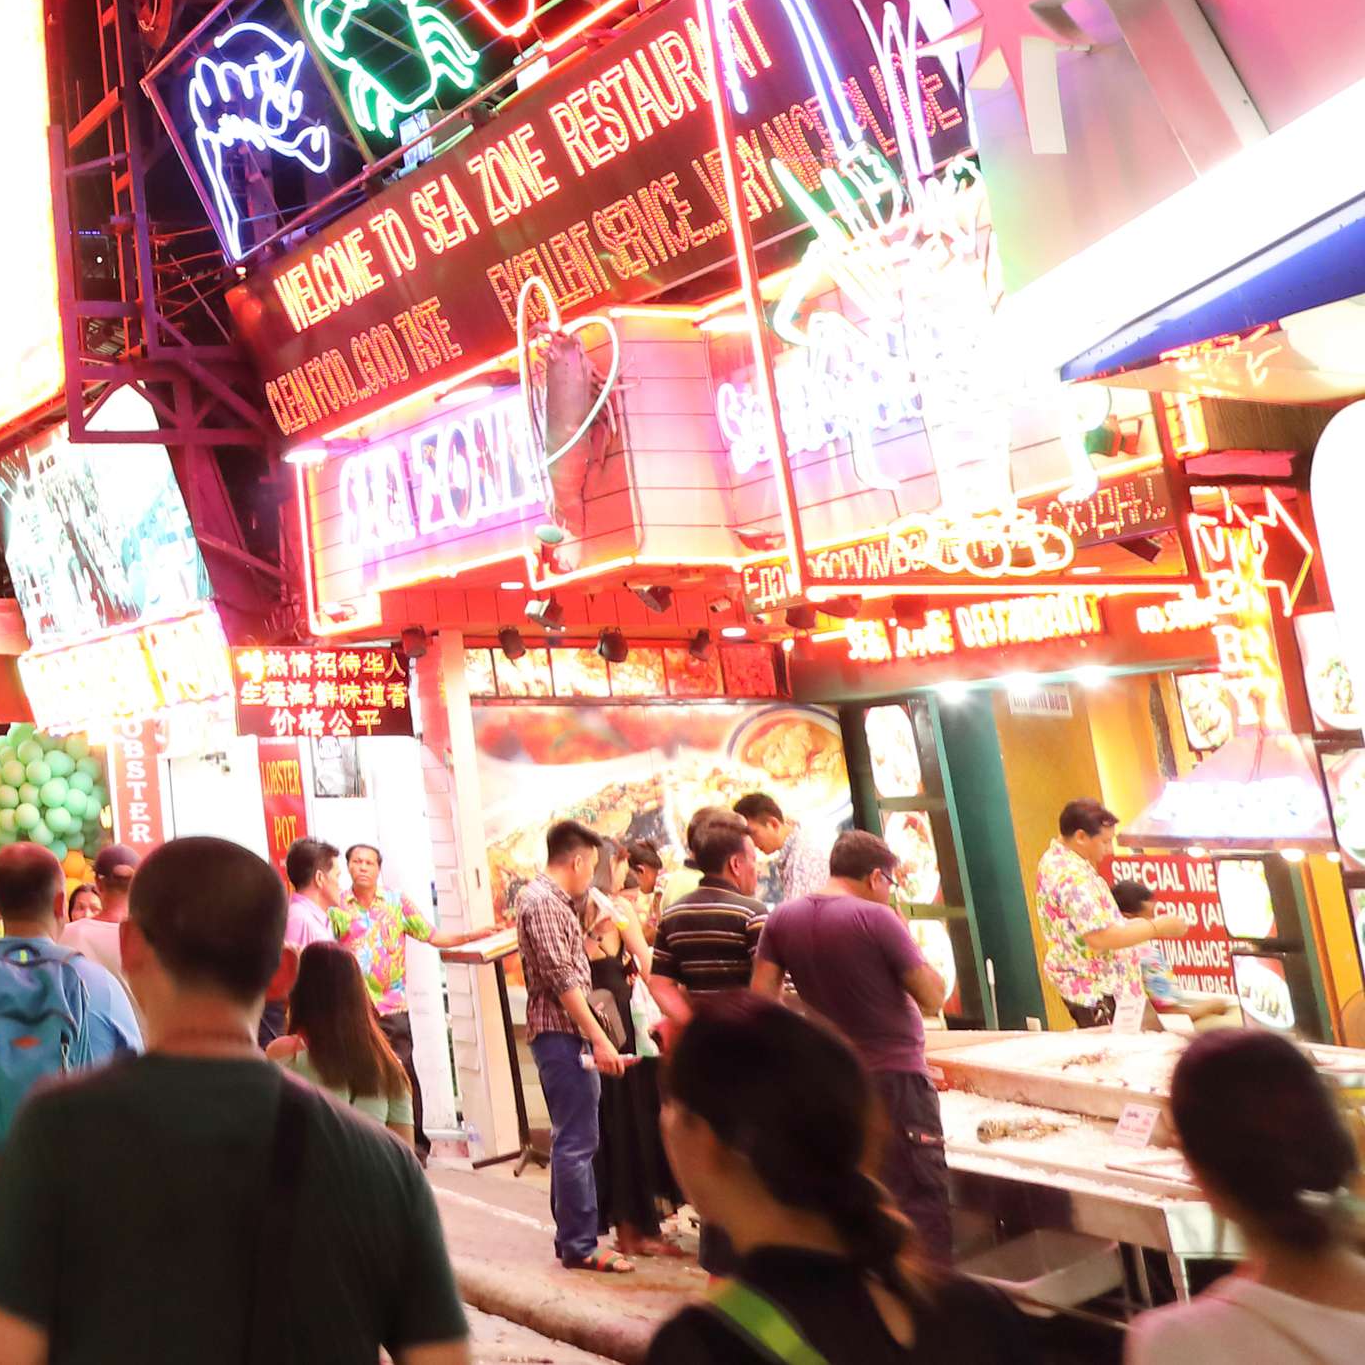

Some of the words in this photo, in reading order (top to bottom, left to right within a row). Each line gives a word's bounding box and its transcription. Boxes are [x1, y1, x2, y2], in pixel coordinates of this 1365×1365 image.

[272, 227, 385, 334] WELCOME
[370, 208, 417, 279] TO
[415, 172, 478, 255] SEA
[468, 123, 559, 227] ZONE
[392, 295, 464, 374] TASTE
[270, 708, 382, 738] 价格公平
[261, 760, 302, 796] LOBSTER
[274, 815, 297, 851] POT
[1111, 859, 1186, 892] SPECIAL
